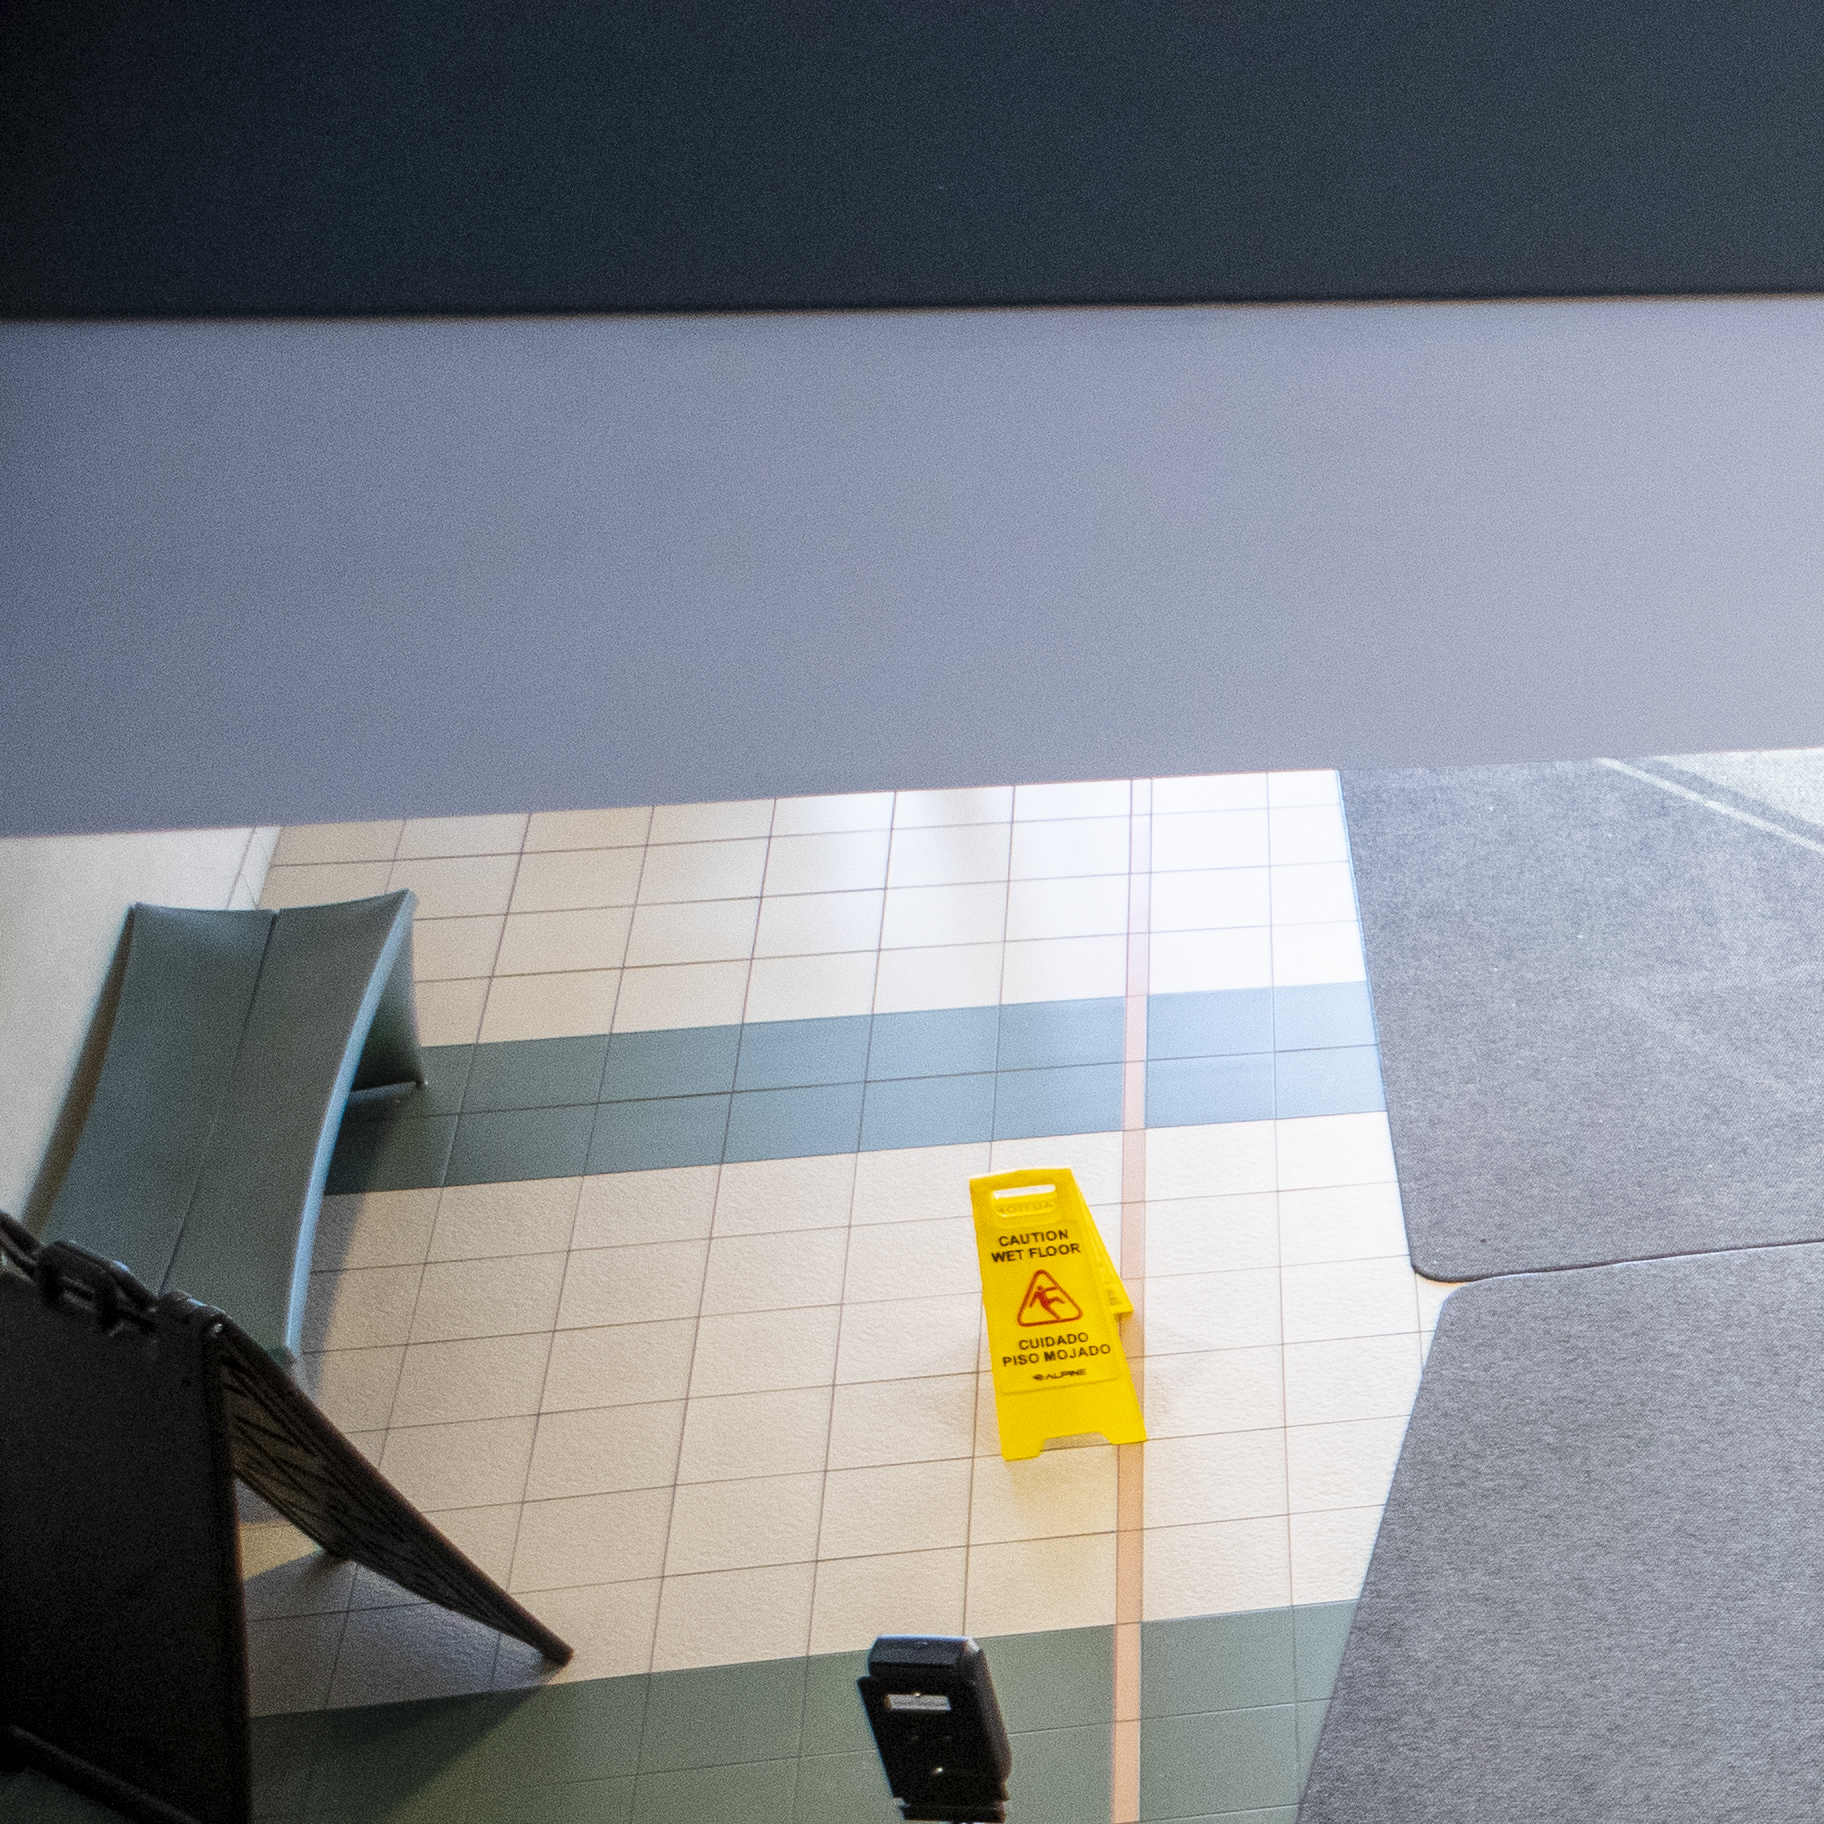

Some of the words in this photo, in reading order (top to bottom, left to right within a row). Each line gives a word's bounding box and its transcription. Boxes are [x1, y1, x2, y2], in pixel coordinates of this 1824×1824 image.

[998, 1229, 1069, 1247] CAUTION
[991, 1249, 1024, 1262] WET
[1028, 1243, 1081, 1259] FLOOR
[1018, 1332, 1089, 1350] CUIDADO
[1002, 1353, 1039, 1367] PISO
[1044, 1344, 1111, 1362] MOJADO
